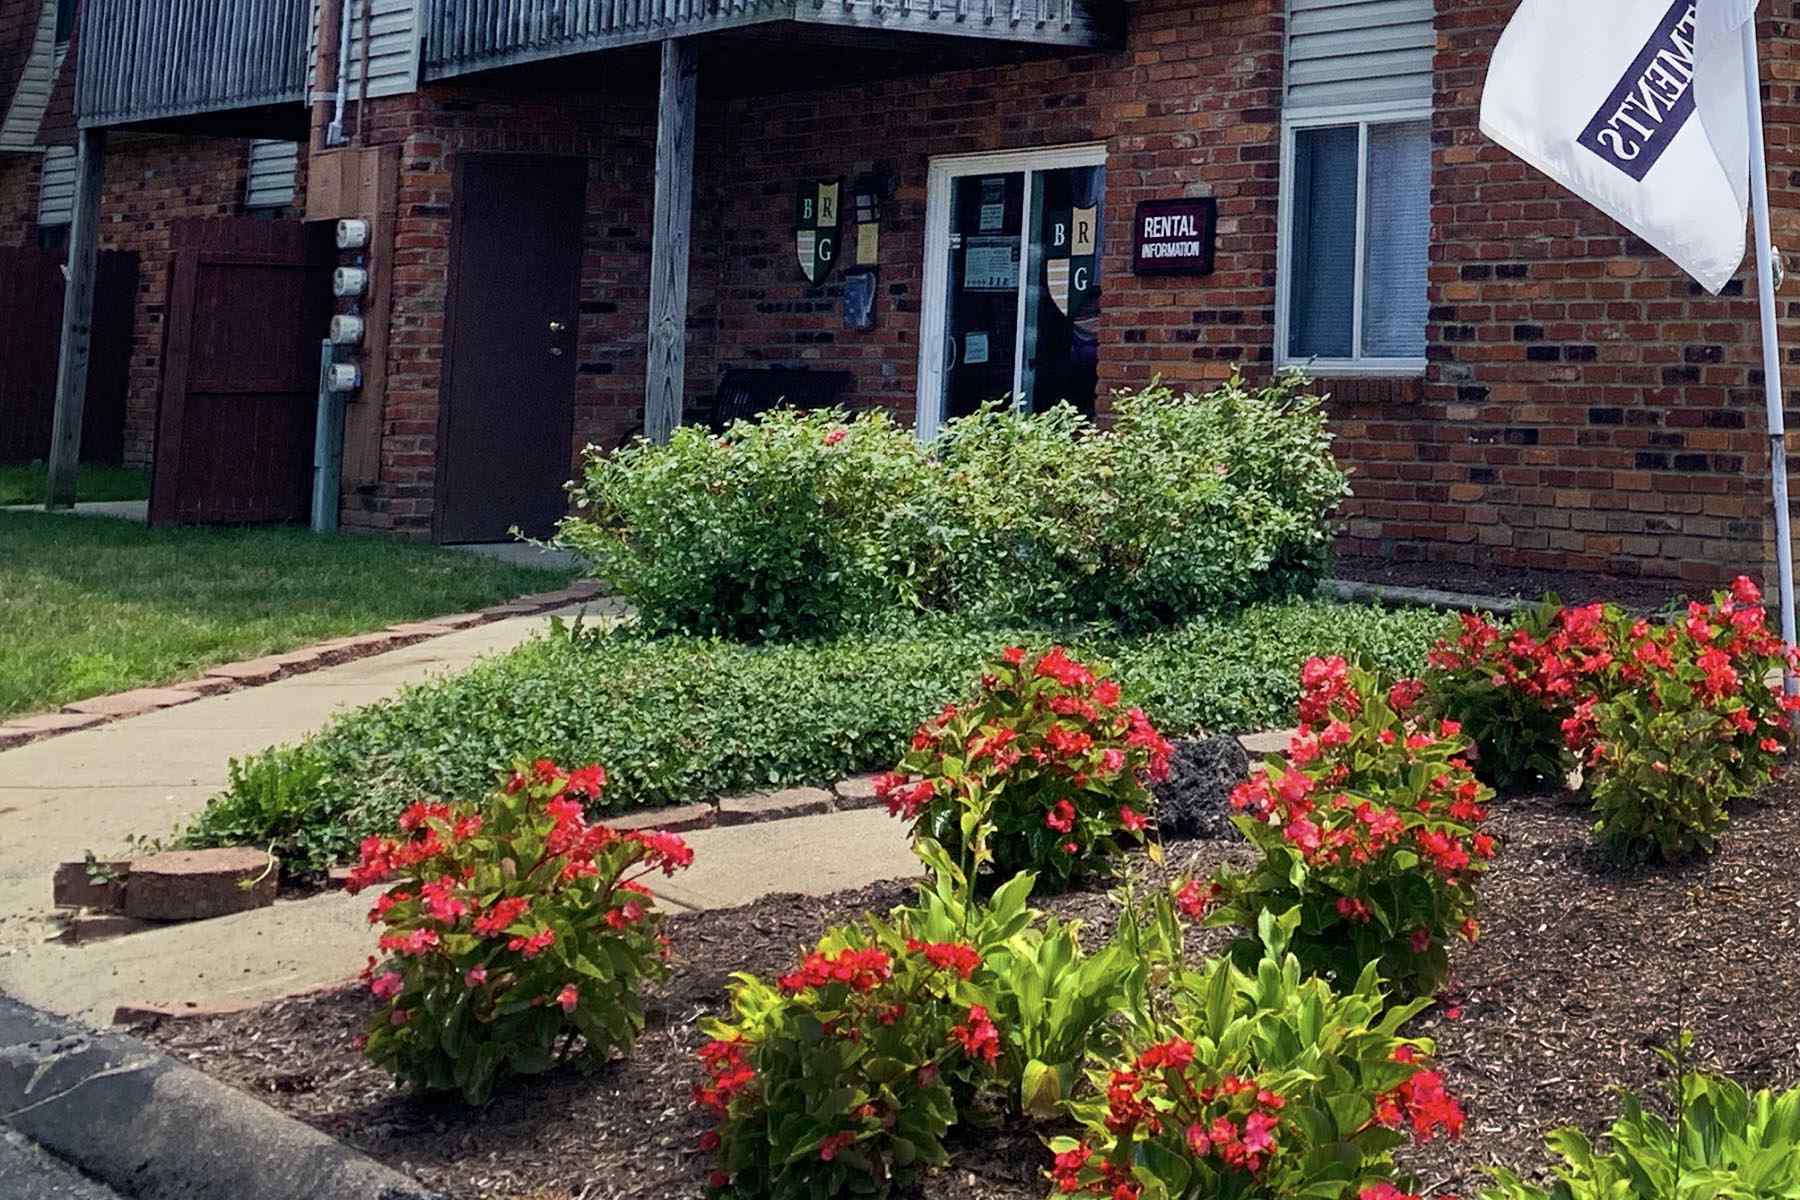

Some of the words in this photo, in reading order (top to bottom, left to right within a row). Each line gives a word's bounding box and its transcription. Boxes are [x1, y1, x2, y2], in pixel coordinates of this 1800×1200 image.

[803, 198, 813, 219] B
[822, 197, 832, 219] R
[1053, 223, 1065, 246] B
[1078, 221, 1088, 244] R
[1144, 215, 1199, 238] RENTAL
[818, 238, 832, 261] G
[1141, 241, 1200, 259] INFORMATION
[1074, 267, 1088, 291] G
